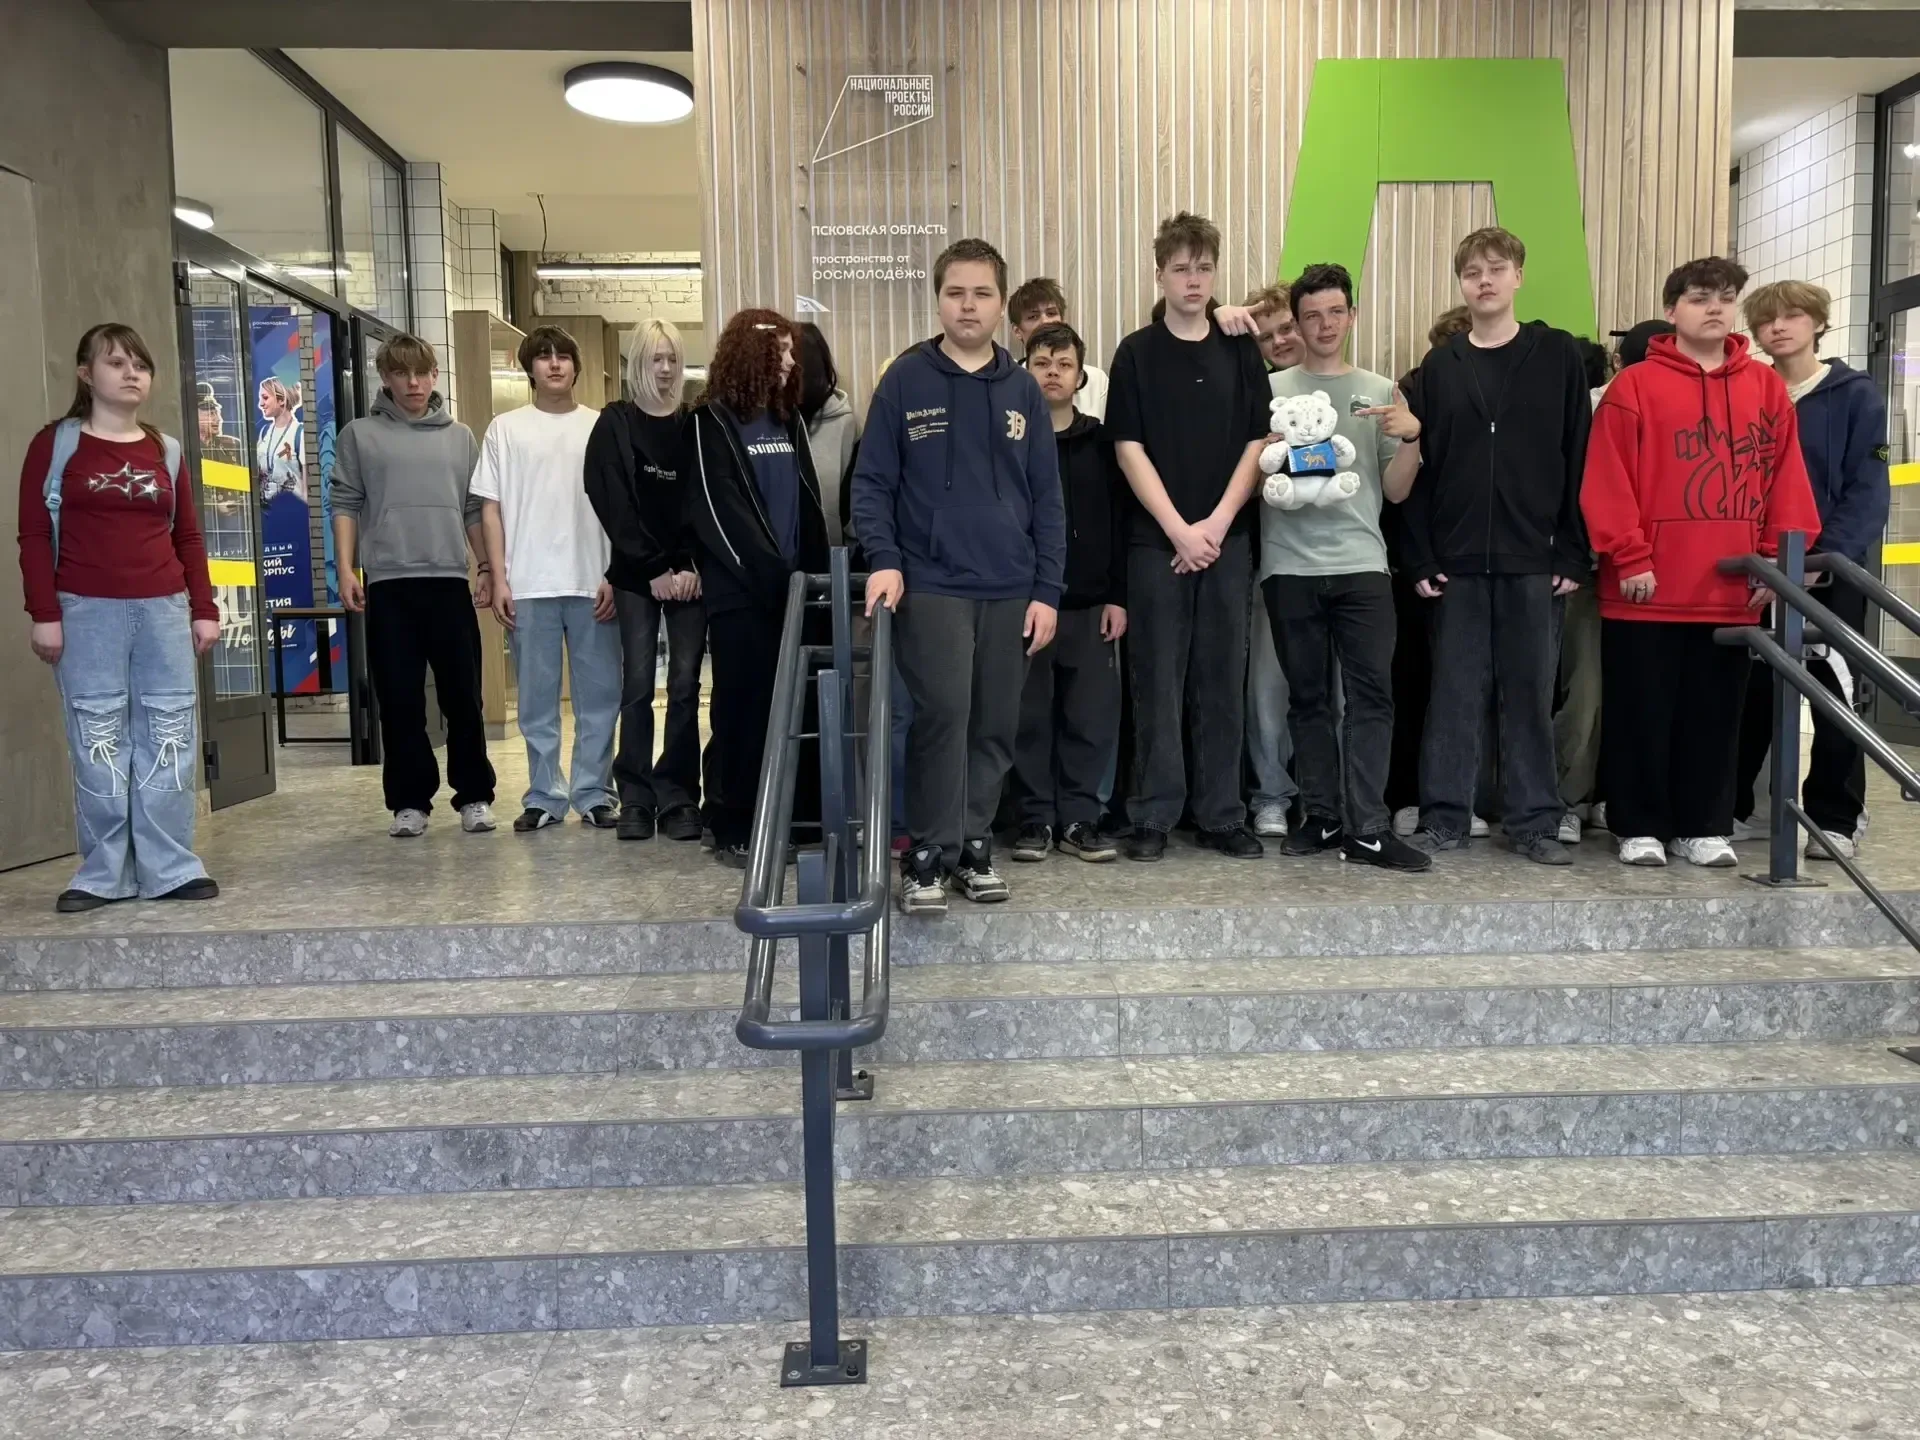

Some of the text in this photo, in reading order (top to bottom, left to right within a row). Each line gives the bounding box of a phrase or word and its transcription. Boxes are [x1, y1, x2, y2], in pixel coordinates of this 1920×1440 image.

[850, 78, 930, 92] НАЦИОНАЛЬНЫЕ
[885, 91, 930, 103] ПРОЕКТЫ
[893, 104, 931, 116] РОССИИ
[811, 224, 947, 236] ПСКОВСКАЯ ОБЛАСТЬ
[812, 255, 910, 266] пространство от
[812, 266, 926, 285] росмолодёжь
